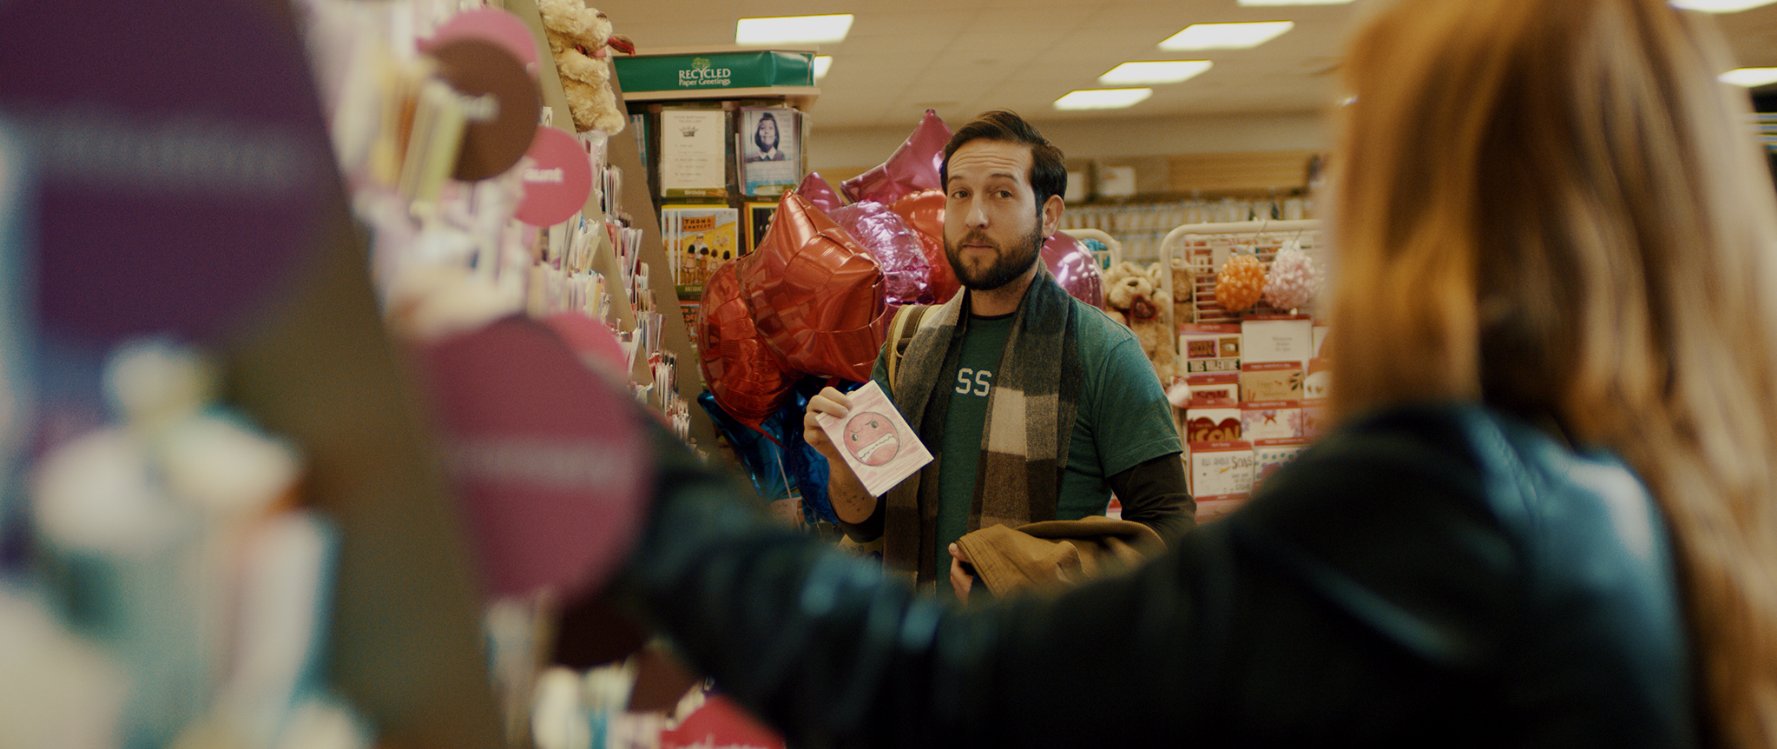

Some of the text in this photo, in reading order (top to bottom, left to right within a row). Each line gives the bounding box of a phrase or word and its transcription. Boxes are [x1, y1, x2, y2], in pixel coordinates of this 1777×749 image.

[678, 67, 731, 80] RECYCLED
[679, 78, 731, 87] Paper Greetings
[955, 367, 992, 397] SS
